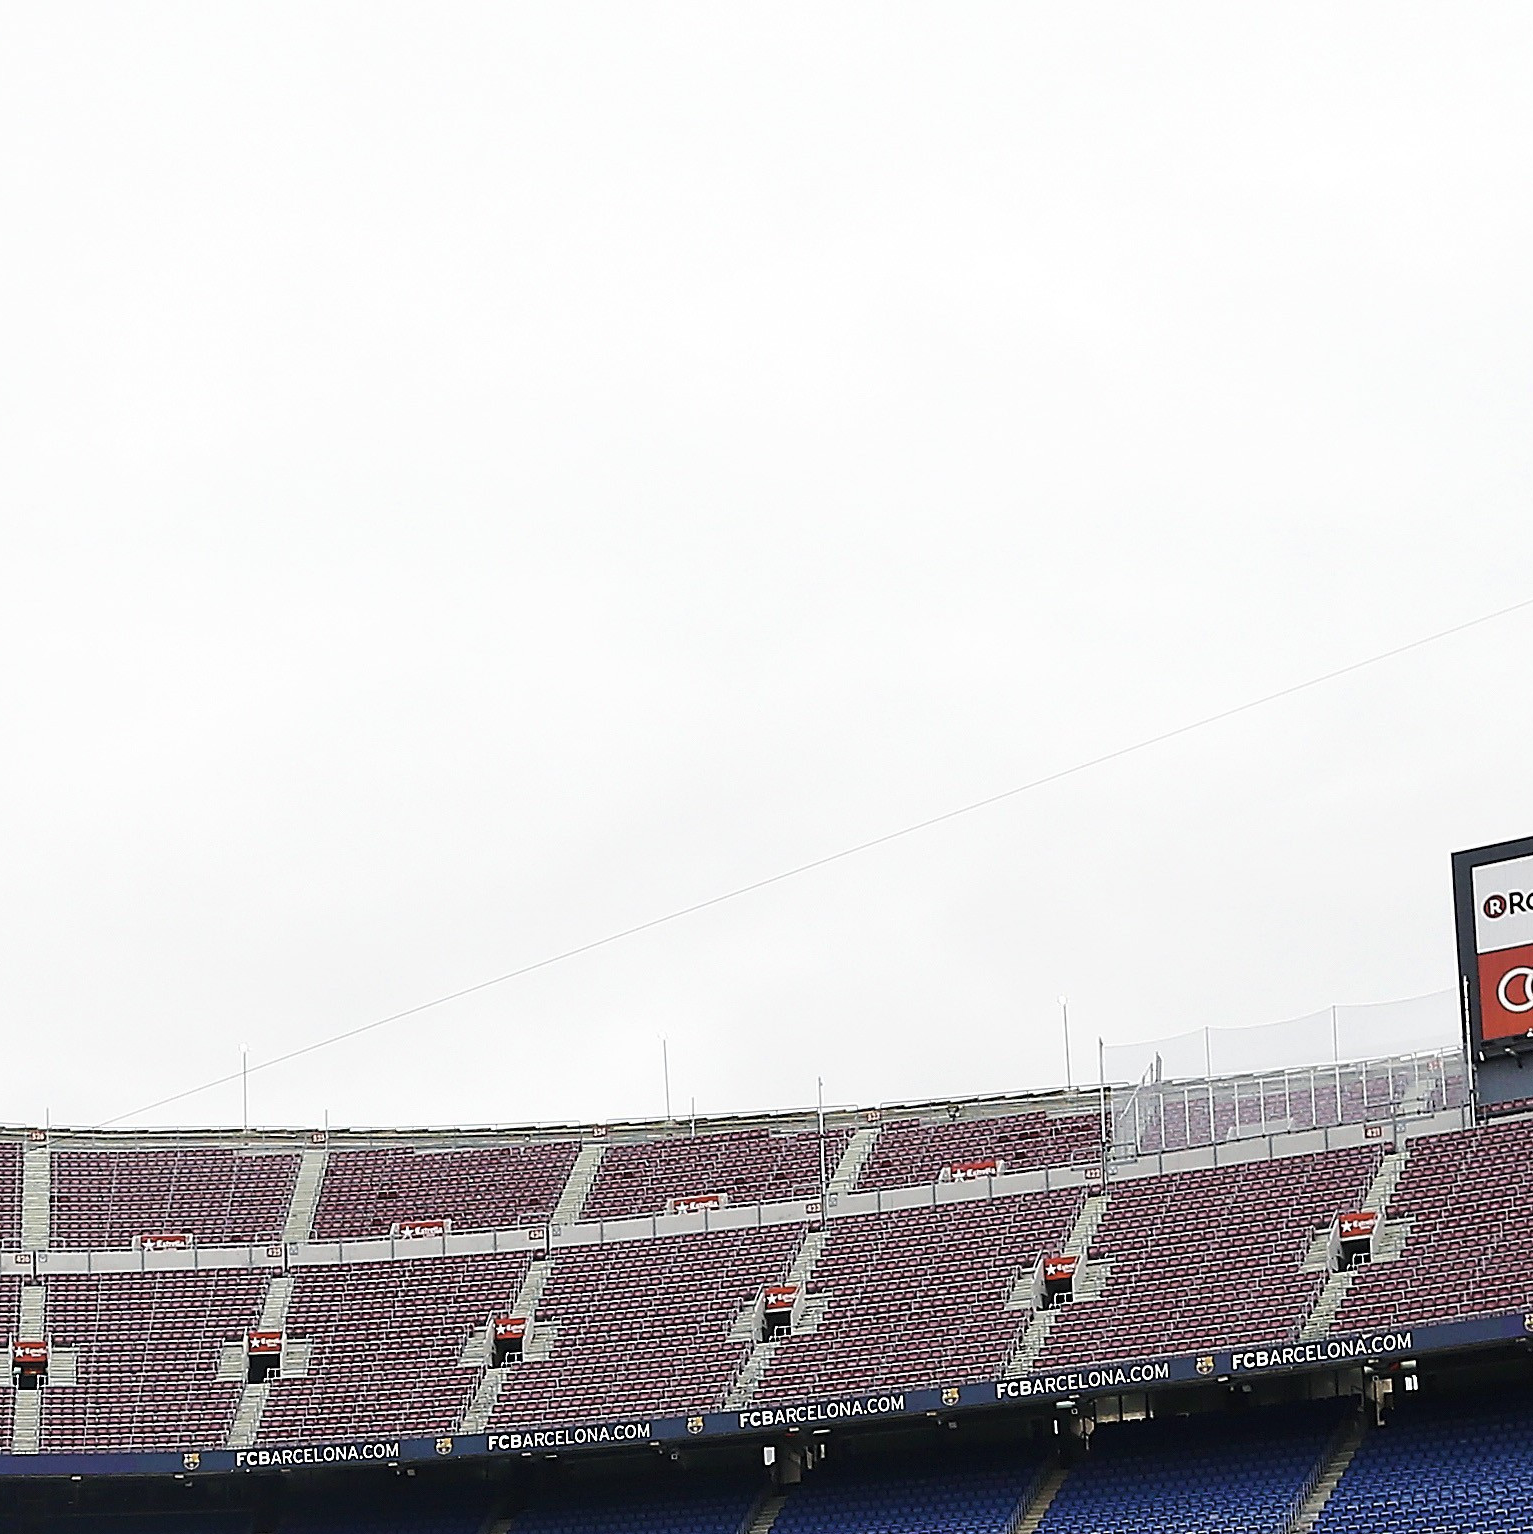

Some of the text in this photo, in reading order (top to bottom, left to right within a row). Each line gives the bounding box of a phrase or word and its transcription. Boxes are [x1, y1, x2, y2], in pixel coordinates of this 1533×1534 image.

[1231, 1333, 1412, 1370] FCBARCELONA.COM
[996, 1363, 1169, 1399] FCBARCELONA.COM
[739, 1395, 905, 1429] FCBARCELONA.COM
[487, 1423, 651, 1451] FCBARCELONA.COM
[236, 1442, 400, 1467] FCBARCELONA.COM
